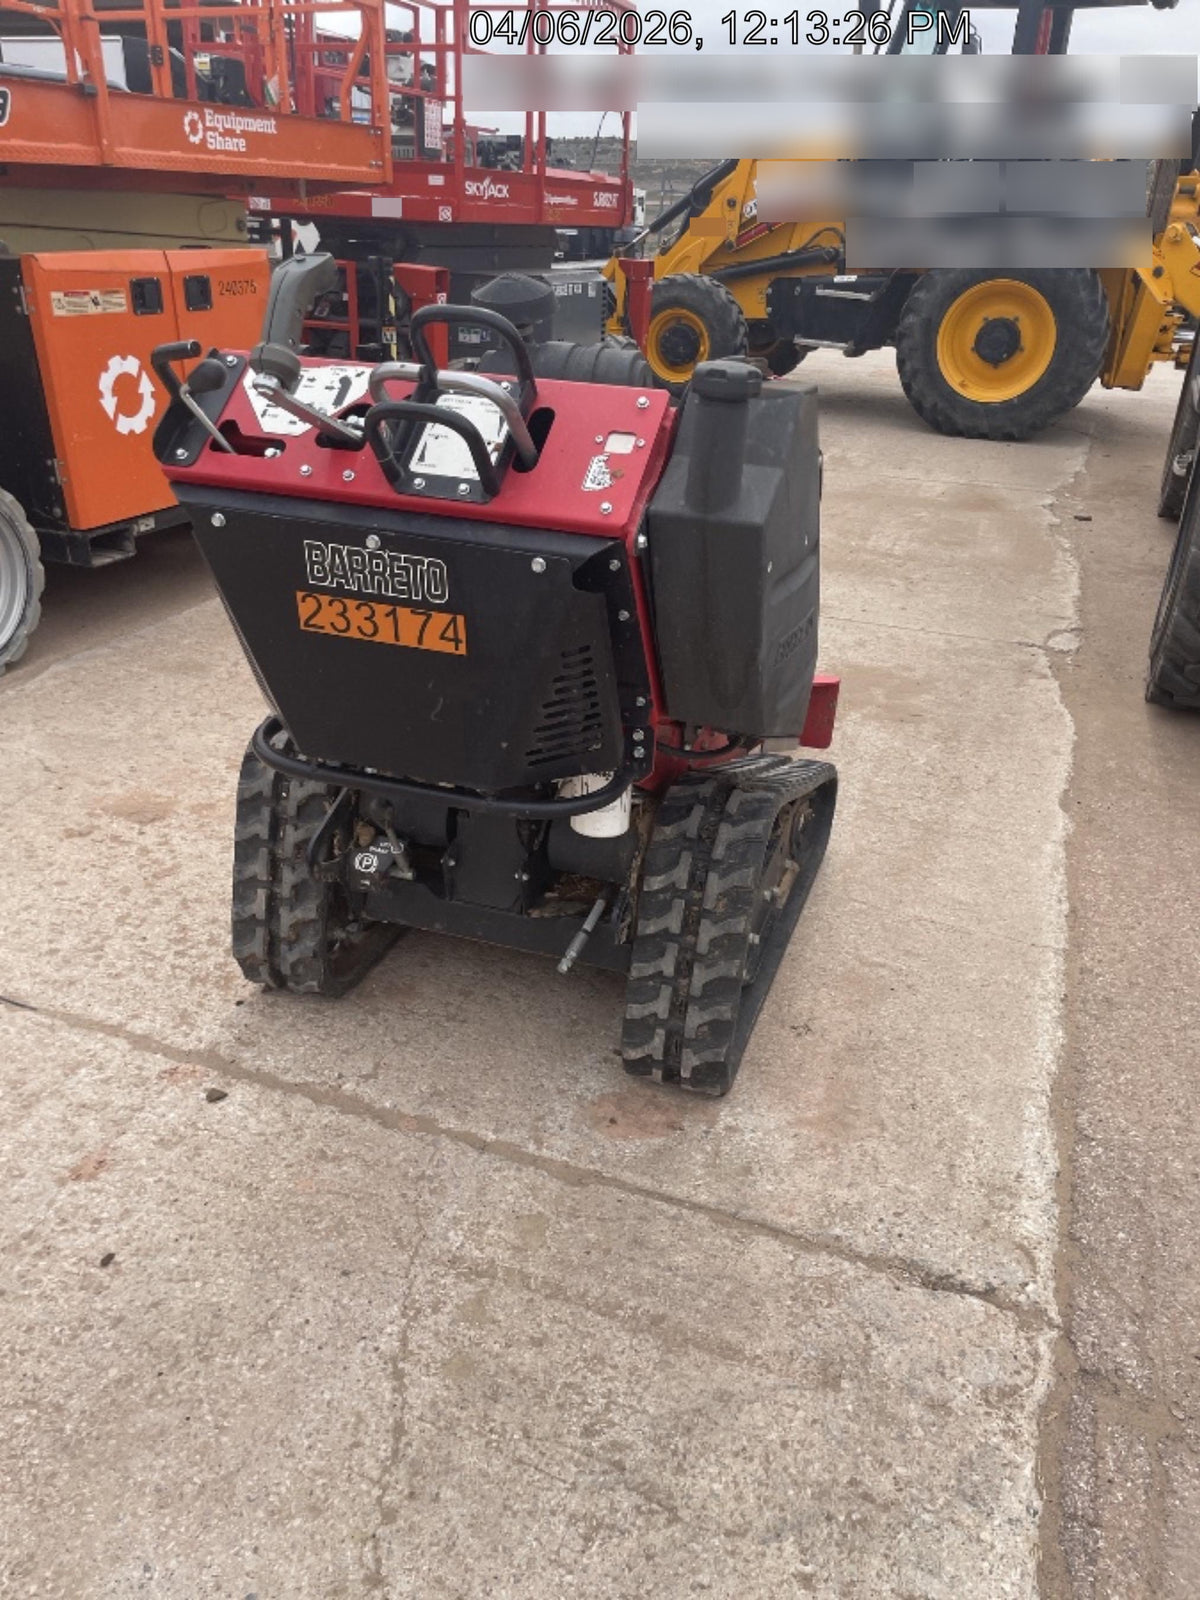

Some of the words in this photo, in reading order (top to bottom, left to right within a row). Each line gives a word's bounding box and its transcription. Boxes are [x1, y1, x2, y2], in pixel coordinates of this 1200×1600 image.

[204, 108, 278, 135] Equipment
[206, 130, 247, 152] Share
[464, 175, 510, 200] SKYJACK
[303, 540, 449, 604] BARRETO
[301, 593, 464, 652] 233174
